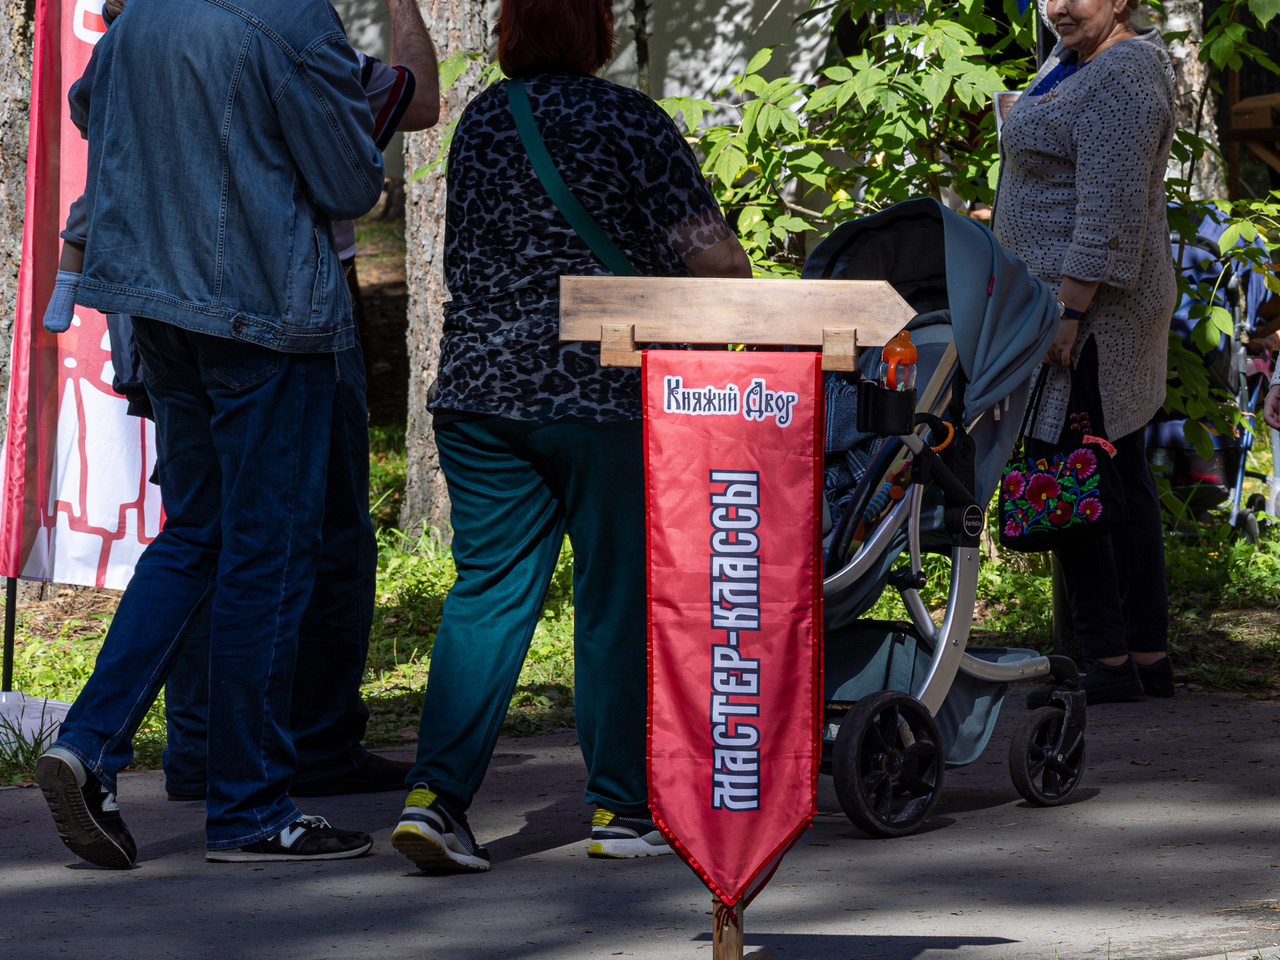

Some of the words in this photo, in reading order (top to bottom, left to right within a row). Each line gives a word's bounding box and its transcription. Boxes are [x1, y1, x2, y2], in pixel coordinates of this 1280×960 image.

[665, 377, 739, 414] Княжий
[745, 380, 797, 425] Двор
[709, 469, 760, 811] МАСТЕР-КЛАССЫ
